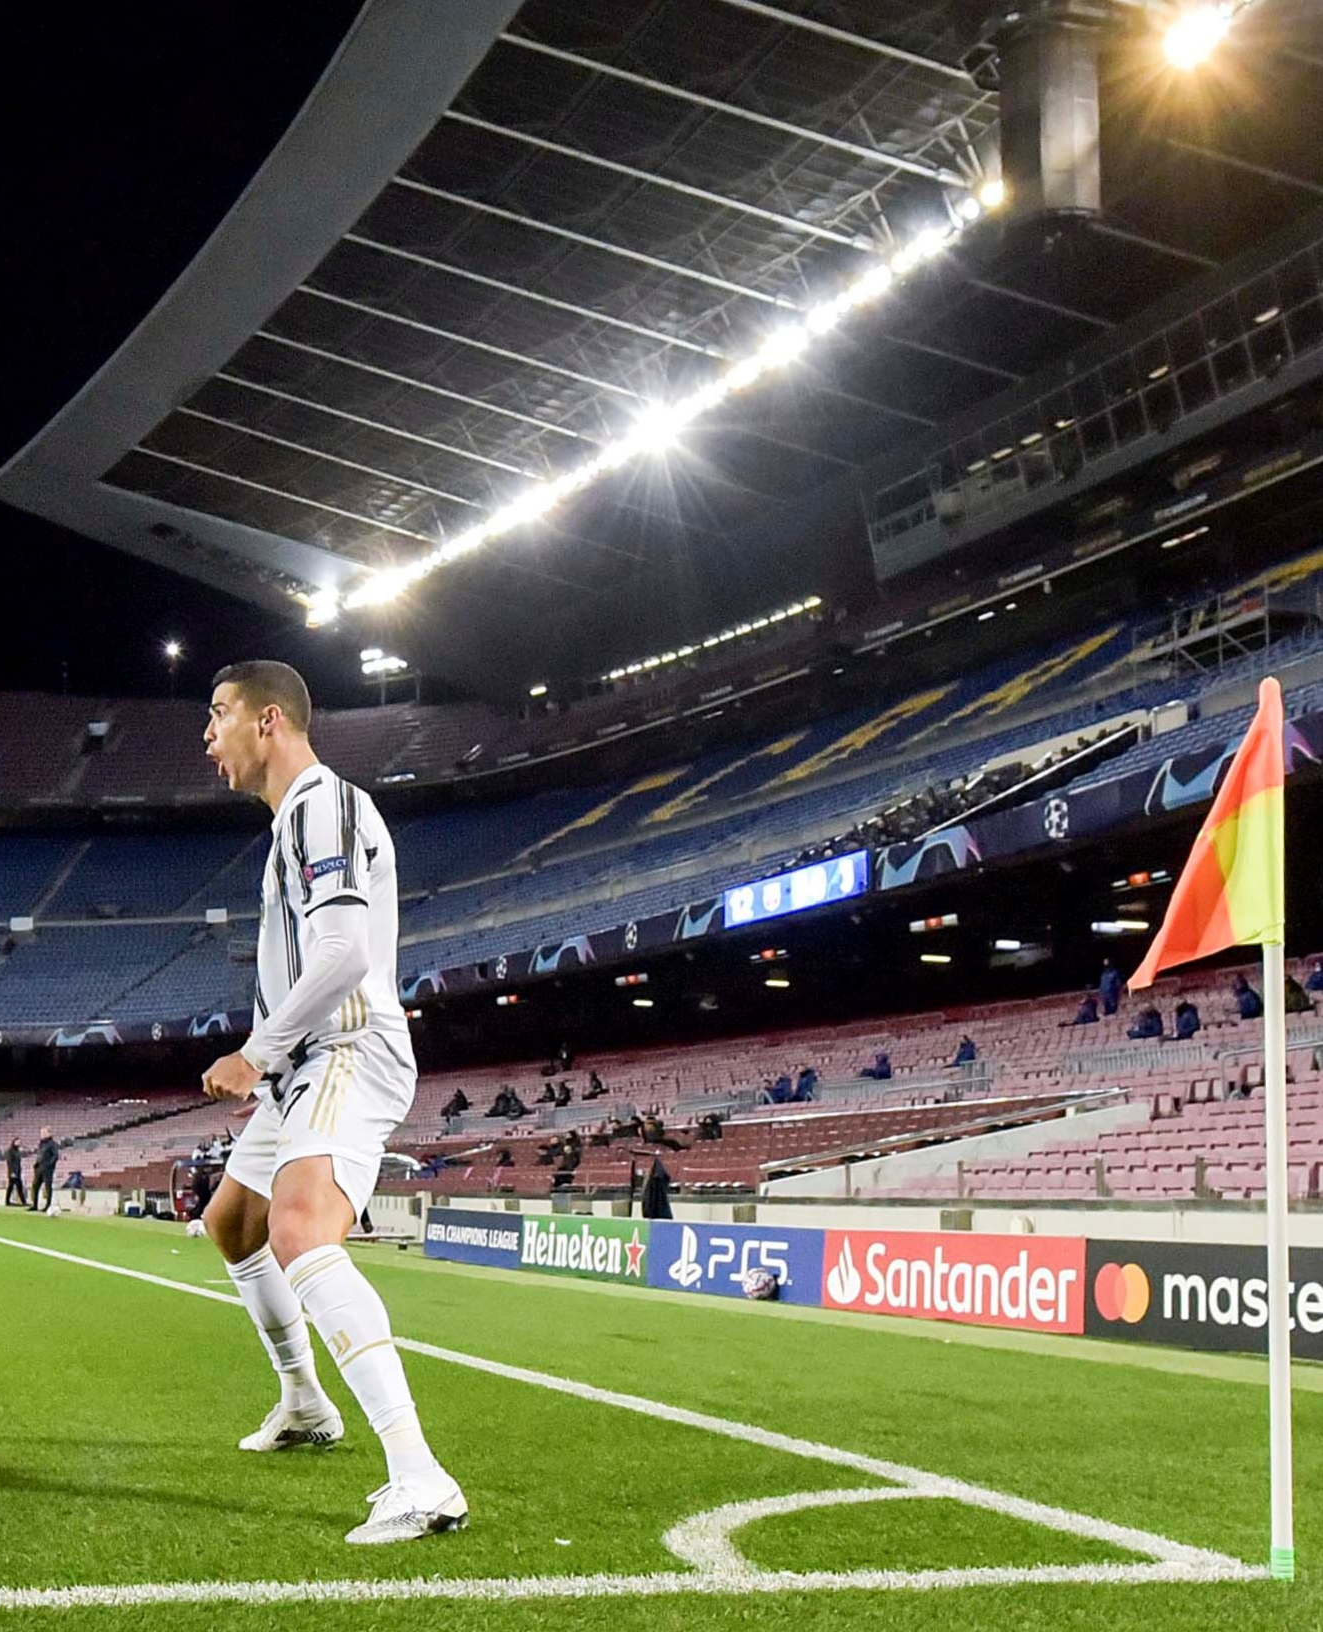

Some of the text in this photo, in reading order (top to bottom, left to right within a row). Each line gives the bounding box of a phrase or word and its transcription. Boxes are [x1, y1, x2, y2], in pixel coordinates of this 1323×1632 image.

[427, 1223, 520, 1250] UEFA CHAMPIONS LEAGUE
[520, 1220, 622, 1274] Heineken
[707, 1237, 789, 1286] PS5
[863, 1242, 1077, 1323] Santander
